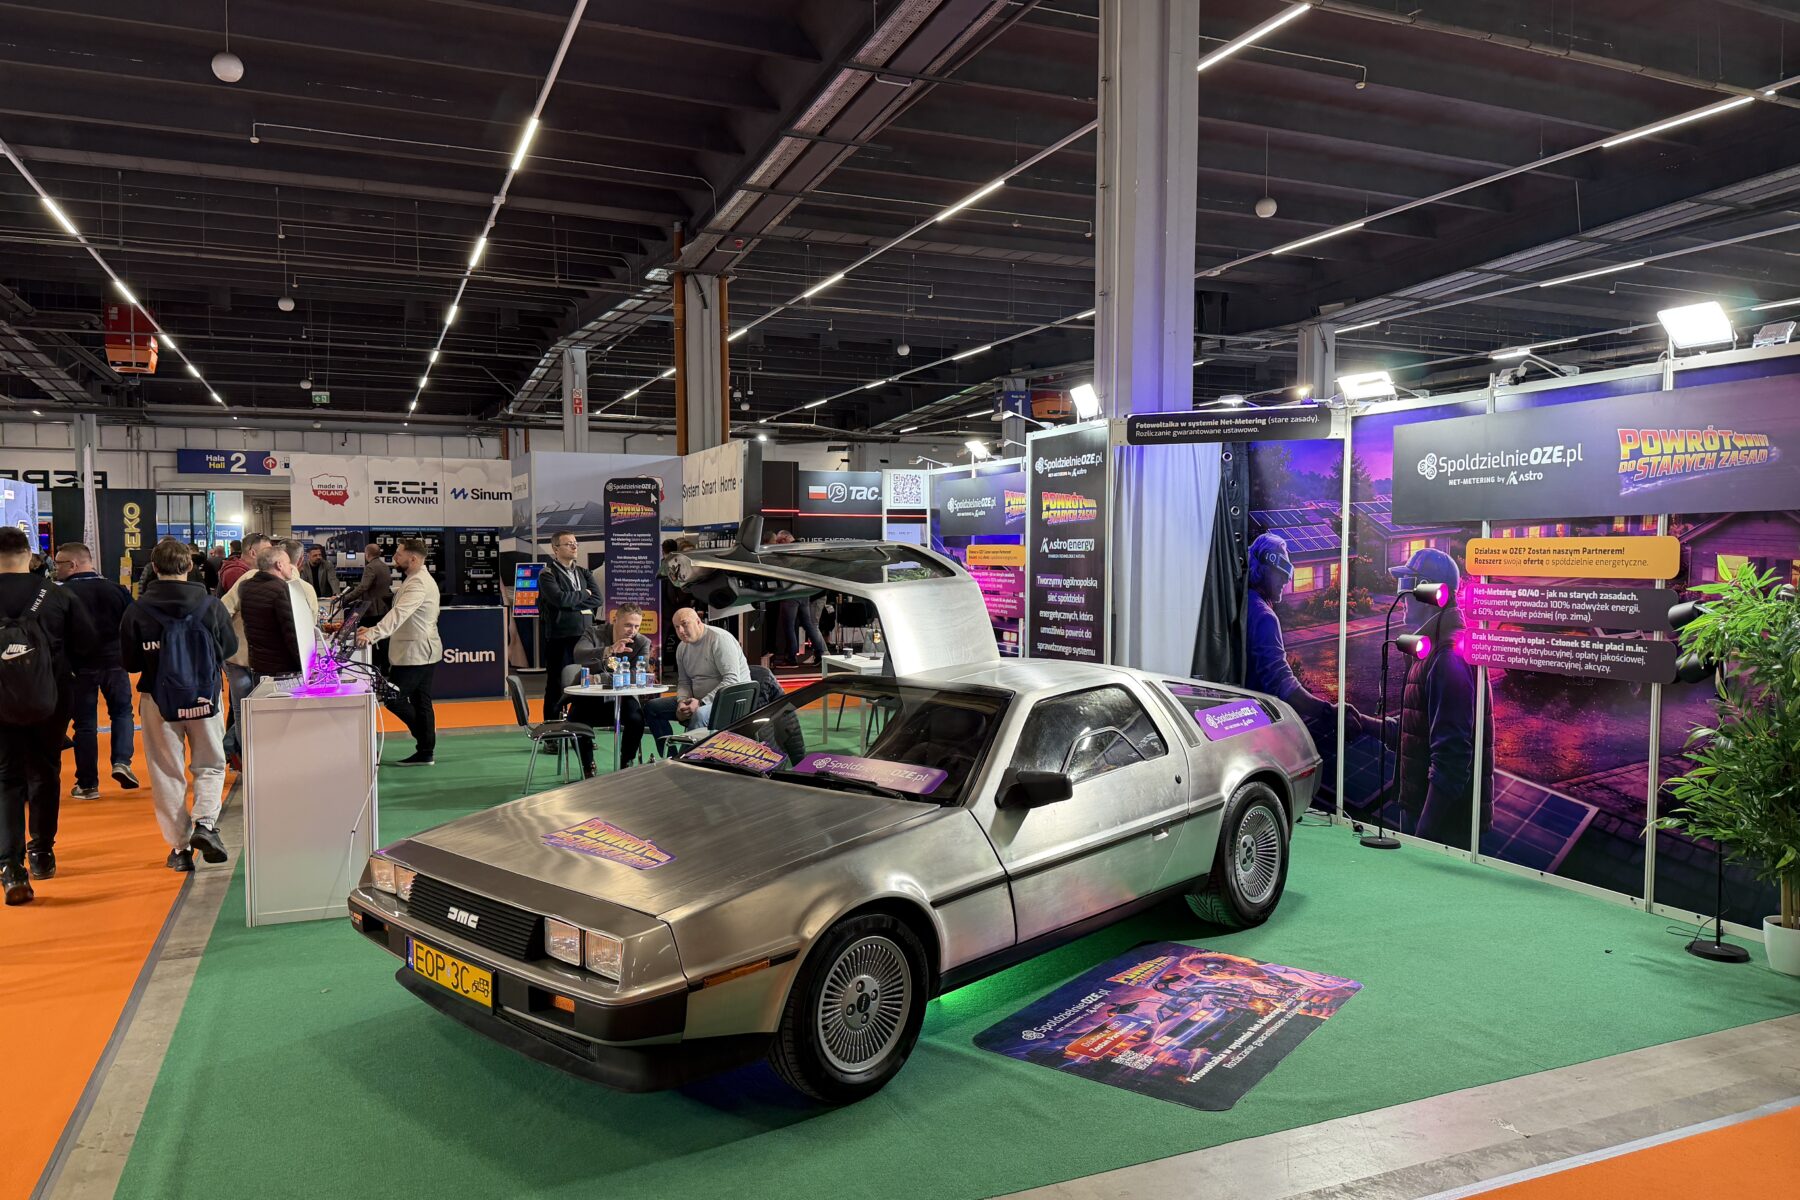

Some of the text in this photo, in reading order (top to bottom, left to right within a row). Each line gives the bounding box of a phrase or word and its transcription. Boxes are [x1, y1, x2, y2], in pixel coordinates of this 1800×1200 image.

[1136, 422, 1179, 430] Fotowoltaika
[1188, 419, 1218, 428] systemie
[1220, 418, 1266, 426] Net-Metering
[1268, 416, 1288, 424] (stare
[1290, 414, 1320, 424] zasady).
[1172, 428, 1221, 437] gwarantowane
[1223, 426, 1260, 434] ustawowo.
[1617, 424, 1733, 460] POWRÓT
[230, 452, 246, 472] 2
[1044, 452, 1103, 472] SpoldzielnieOZE.pl
[1438, 443, 1583, 476] SpoldzielnieOZE.pl
[1618, 449, 1768, 482] DO STARYCH ZASAD
[374, 480, 438, 494] TECH
[1448, 476, 1495, 486] NET-METERING
[1497, 476, 1505, 484] by
[470, 488, 512, 501] Sinum
[682, 476, 736, 502] System Smart Home
[374, 496, 438, 505] STEROWNIKI
[123, 502, 141, 556] EKO
[1068, 540, 1094, 551] energy
[1582, 547, 1625, 555] Partnerem!
[1523, 558, 1544, 566] ofertę
[1552, 558, 1594, 566] spółdzielnie
[1595, 559, 1649, 568] energetyczne.
[1036, 575, 1098, 589] Tworzymy ogólnopolską
[31, 589, 47, 612] NIKE AIR
[1058, 594, 1085, 605] spółdzielni
[1473, 588, 1516, 598] Net-Metering
[1518, 590, 1539, 598] 60/40
[1546, 591, 1557, 600] jak
[1569, 591, 1598, 600] starych
[1599, 592, 1638, 600] zasadach.
[1473, 598, 1508, 606] Prosument
[1509, 600, 1548, 609] wprowadza
[1550, 601, 1570, 609] 100%
[1572, 602, 1609, 612] nadwyżek
[1040, 610, 1093, 621] energetycznych, która
[1478, 608, 1493, 616] 60%
[1495, 609, 1527, 619] odzyskuje
[1529, 610, 1553, 621] później
[1555, 612, 1568, 622] (np.
[1570, 612, 1592, 622] zimą).
[1065, 627, 1084, 638] powrót
[1084, 630, 1092, 639] do
[6, 644, 28, 653] NIKE
[1037, 642, 1095, 656] sprawdzonego systemu
[1488, 634, 1526, 644] kluczowych
[1527, 636, 1545, 646] opłat
[1551, 638, 1579, 647] Członek
[1581, 640, 1590, 648] SE
[1592, 641, 1604, 650] nie
[1605, 642, 1624, 652] płaci
[443, 649, 495, 663] Sinum
[1472, 643, 1491, 652] opłaty
[1492, 644, 1521, 654] zmiennej
[1522, 646, 1574, 659] dystrybucyjnej,
[1575, 651, 1598, 660] opłaty
[1471, 653, 1491, 662] opłaty
[1507, 656, 1528, 665] opłaty
[1584, 663, 1611, 673] akcyzy.
[178, 704, 211, 718] PUMA
[416, 944, 470, 994] EOP 3C
[1186, 1052, 1228, 1083] Fotowoltaika
